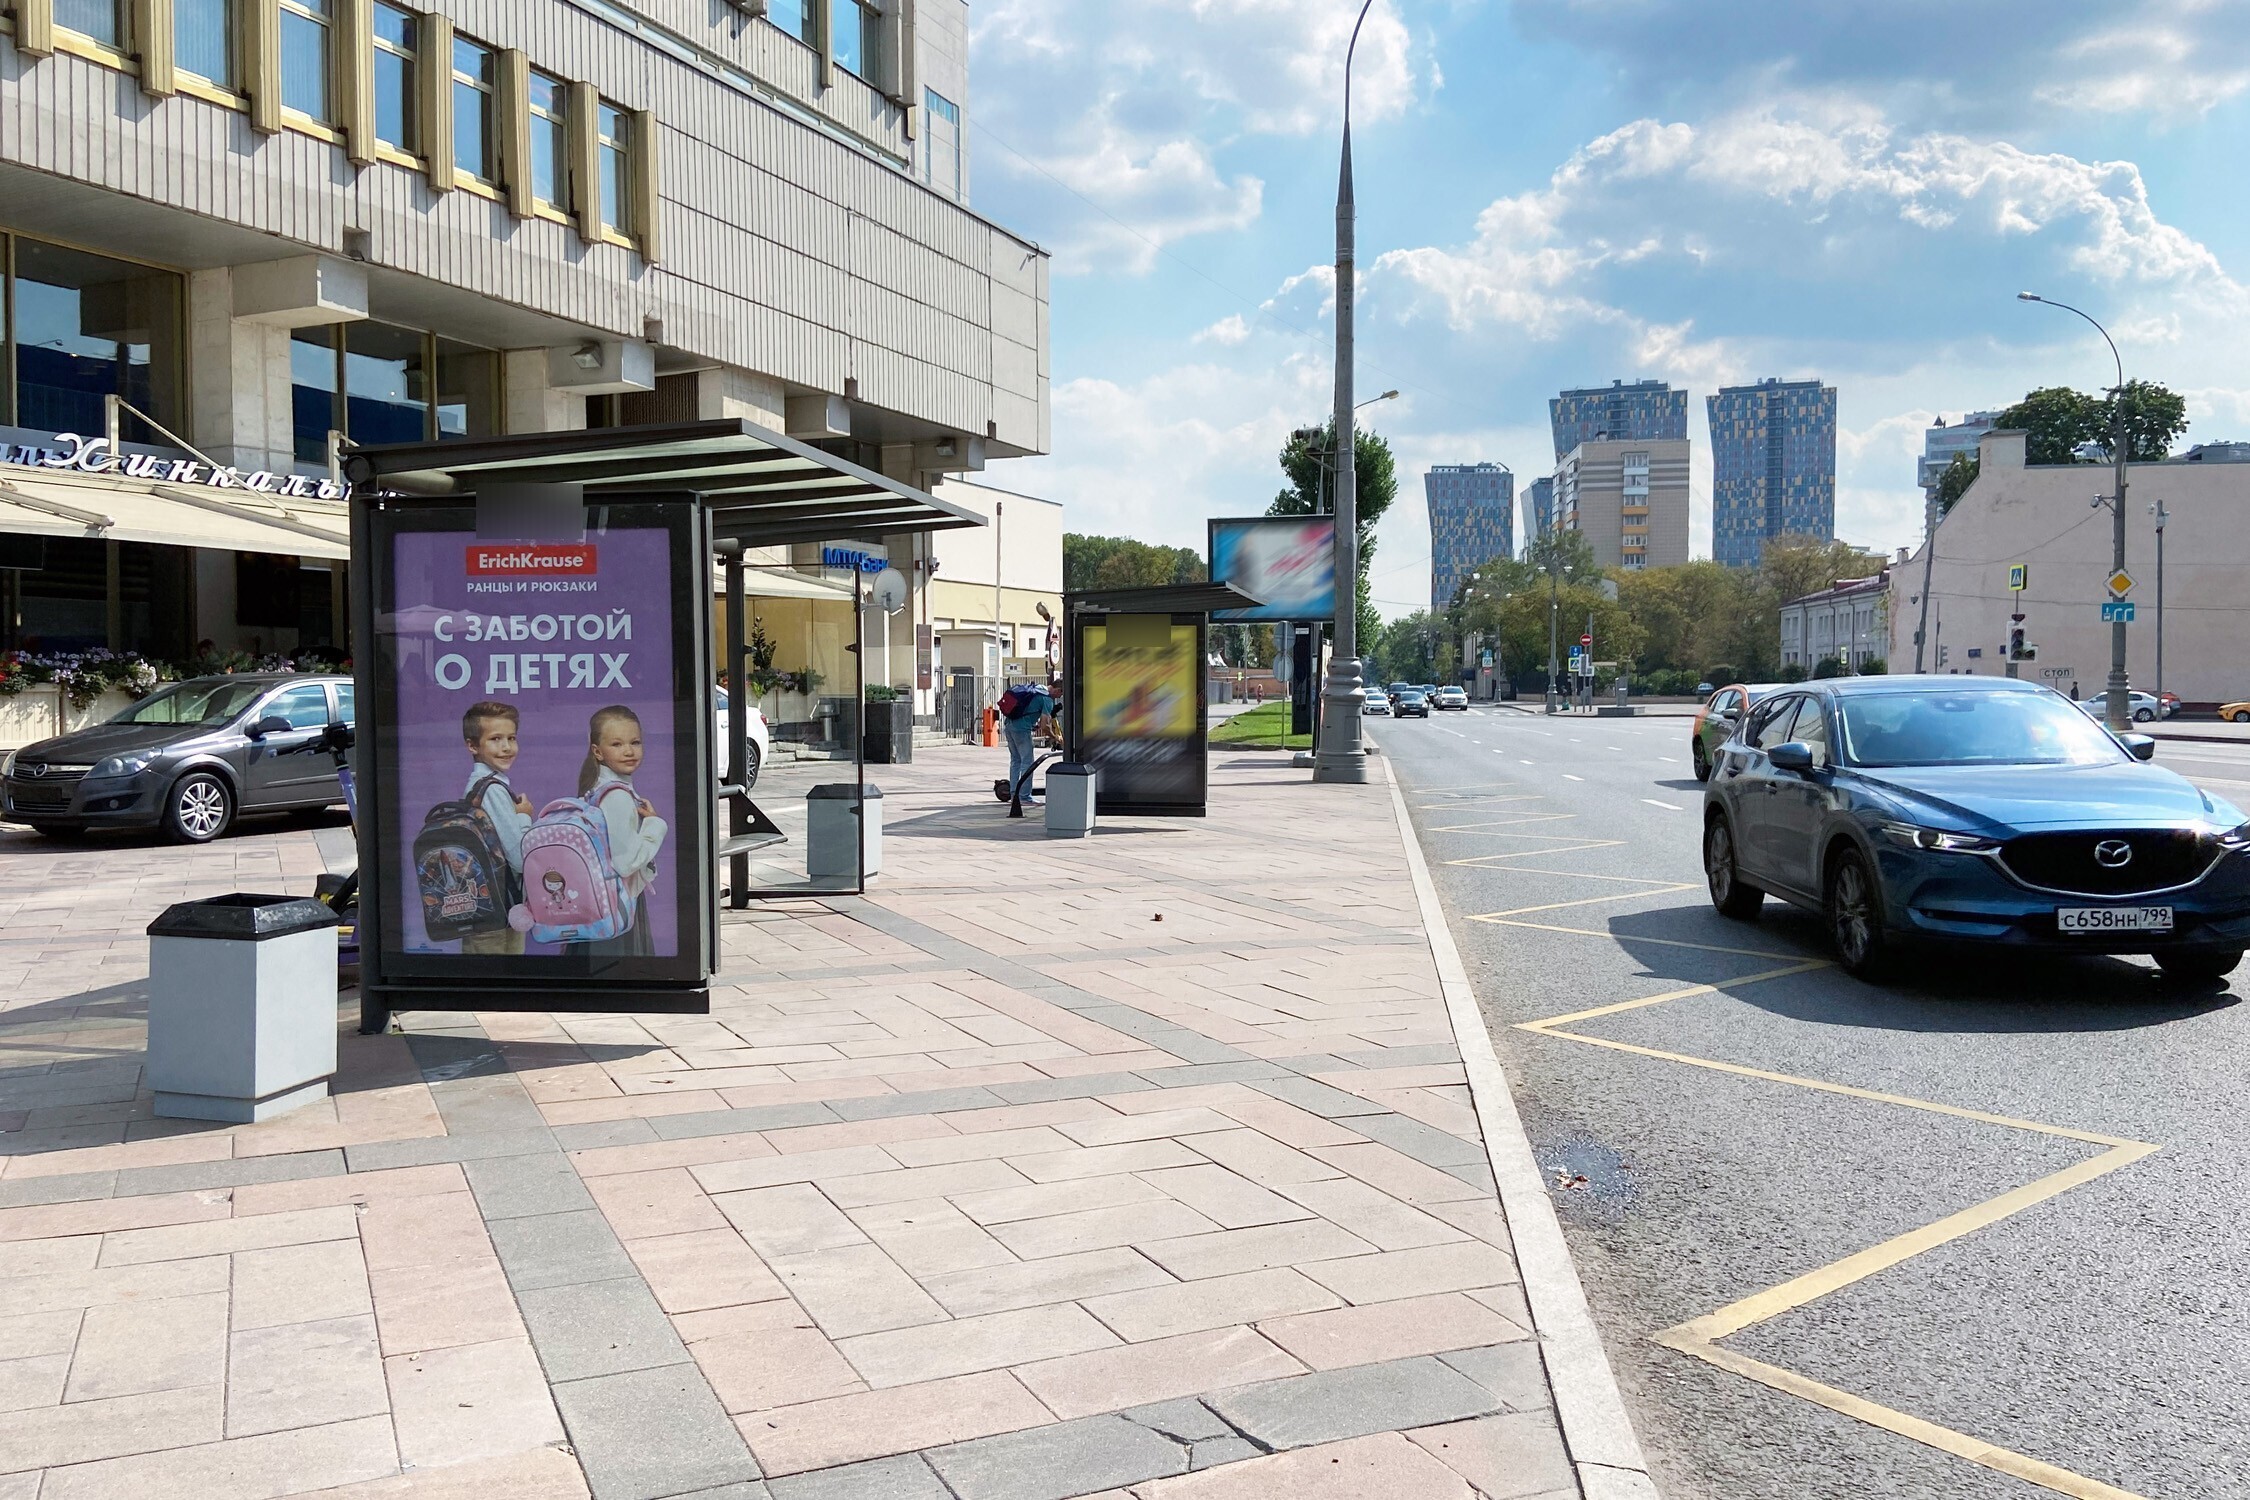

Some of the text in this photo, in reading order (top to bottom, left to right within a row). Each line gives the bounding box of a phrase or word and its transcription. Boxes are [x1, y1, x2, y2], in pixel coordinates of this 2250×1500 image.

[41, 432, 352, 500] Хинкаль
[479, 553, 584, 568] ErichKrause
[467, 581, 598, 593] РАНЦЫ И РЮКЗАКИ
[434, 608, 632, 642] С ЗАБОТОЙ
[434, 653, 632, 694] О ДЕТЯХ
[2141, 909, 2168, 922] 799
